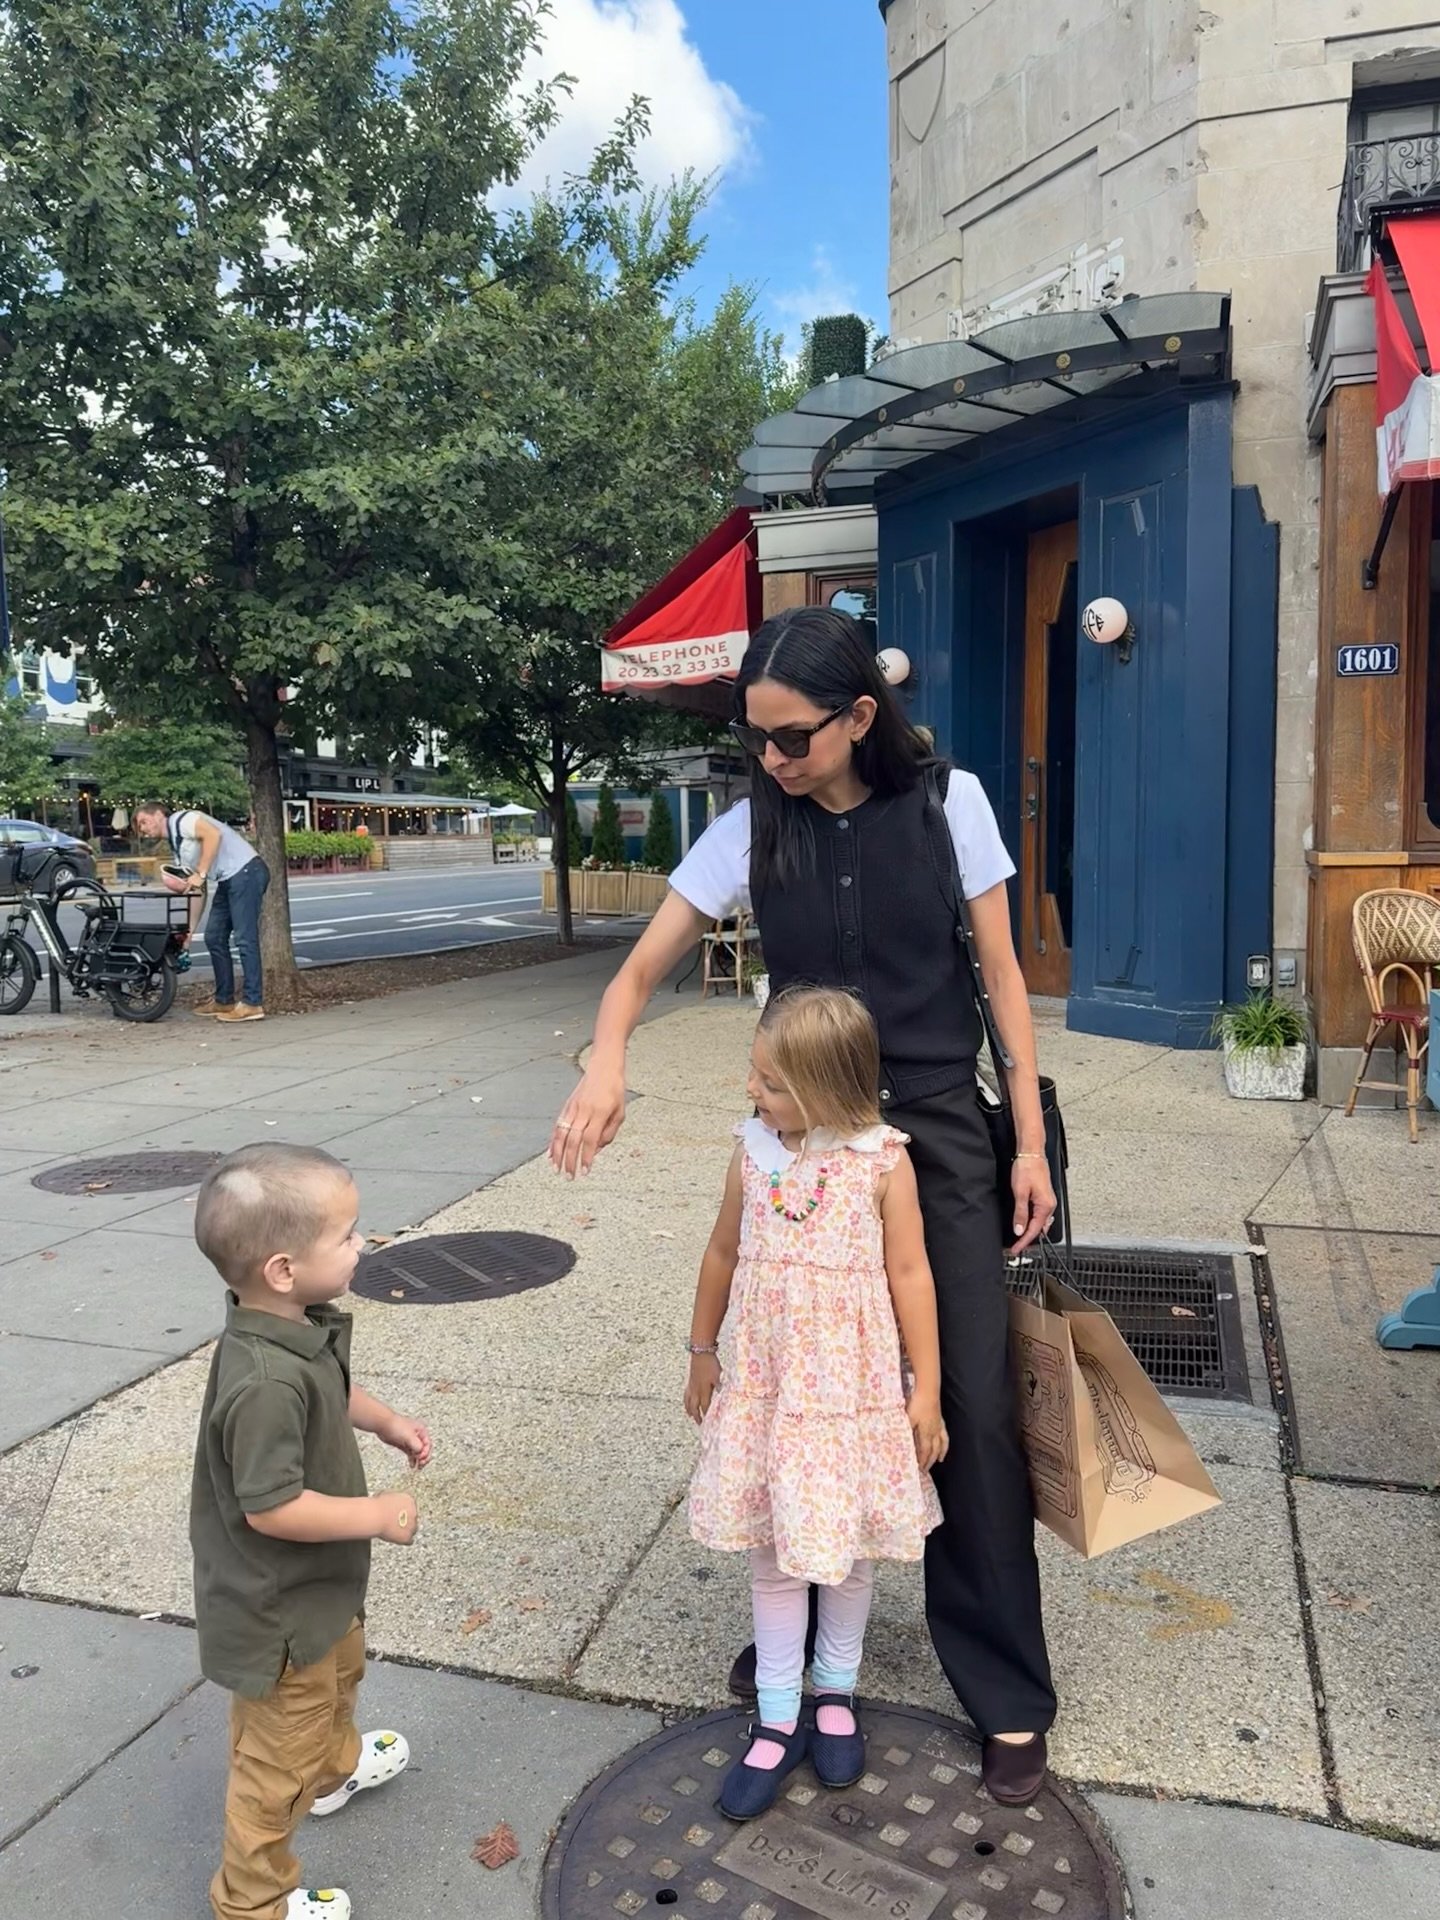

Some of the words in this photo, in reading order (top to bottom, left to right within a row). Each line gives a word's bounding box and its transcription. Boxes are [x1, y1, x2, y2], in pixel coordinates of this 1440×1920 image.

[620, 641, 728, 664] TELEPHONE
[1343, 647, 1392, 672] 1601
[618, 667, 638, 678] 20
[642, 666, 659, 677] 23
[662, 664, 682, 676] 32
[687, 660, 706, 673] 33
[711, 656, 731, 669] 33
